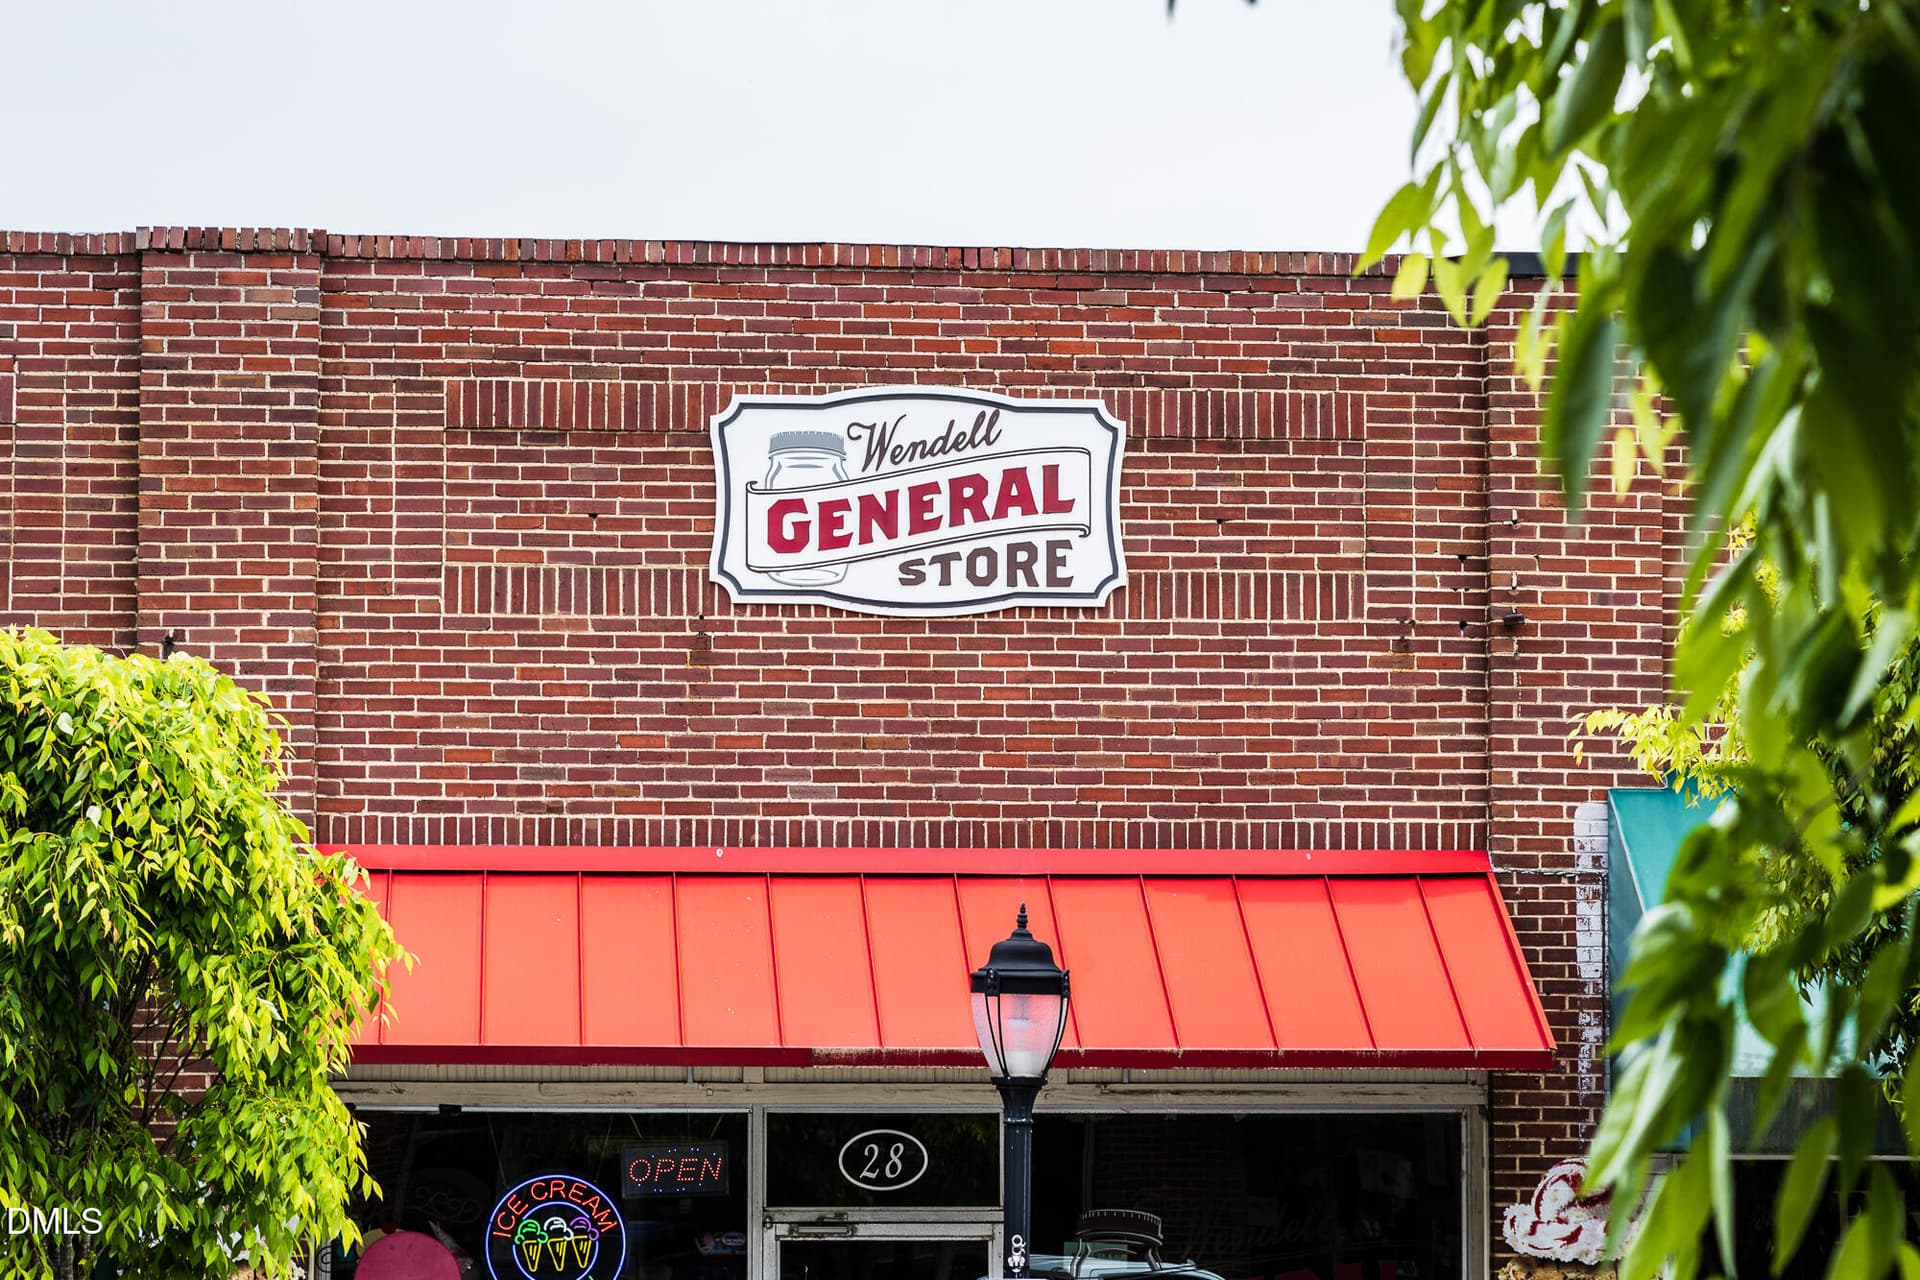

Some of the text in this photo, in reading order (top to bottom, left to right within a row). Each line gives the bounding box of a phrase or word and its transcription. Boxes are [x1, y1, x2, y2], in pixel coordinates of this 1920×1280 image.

[847, 408, 1002, 473] Wendell
[767, 464, 1076, 554] GENERAL
[899, 539, 1074, 588] STORE
[627, 1156, 723, 1183] OPEN
[859, 1142, 904, 1179] 28
[492, 1179, 618, 1238] ICE CREAM
